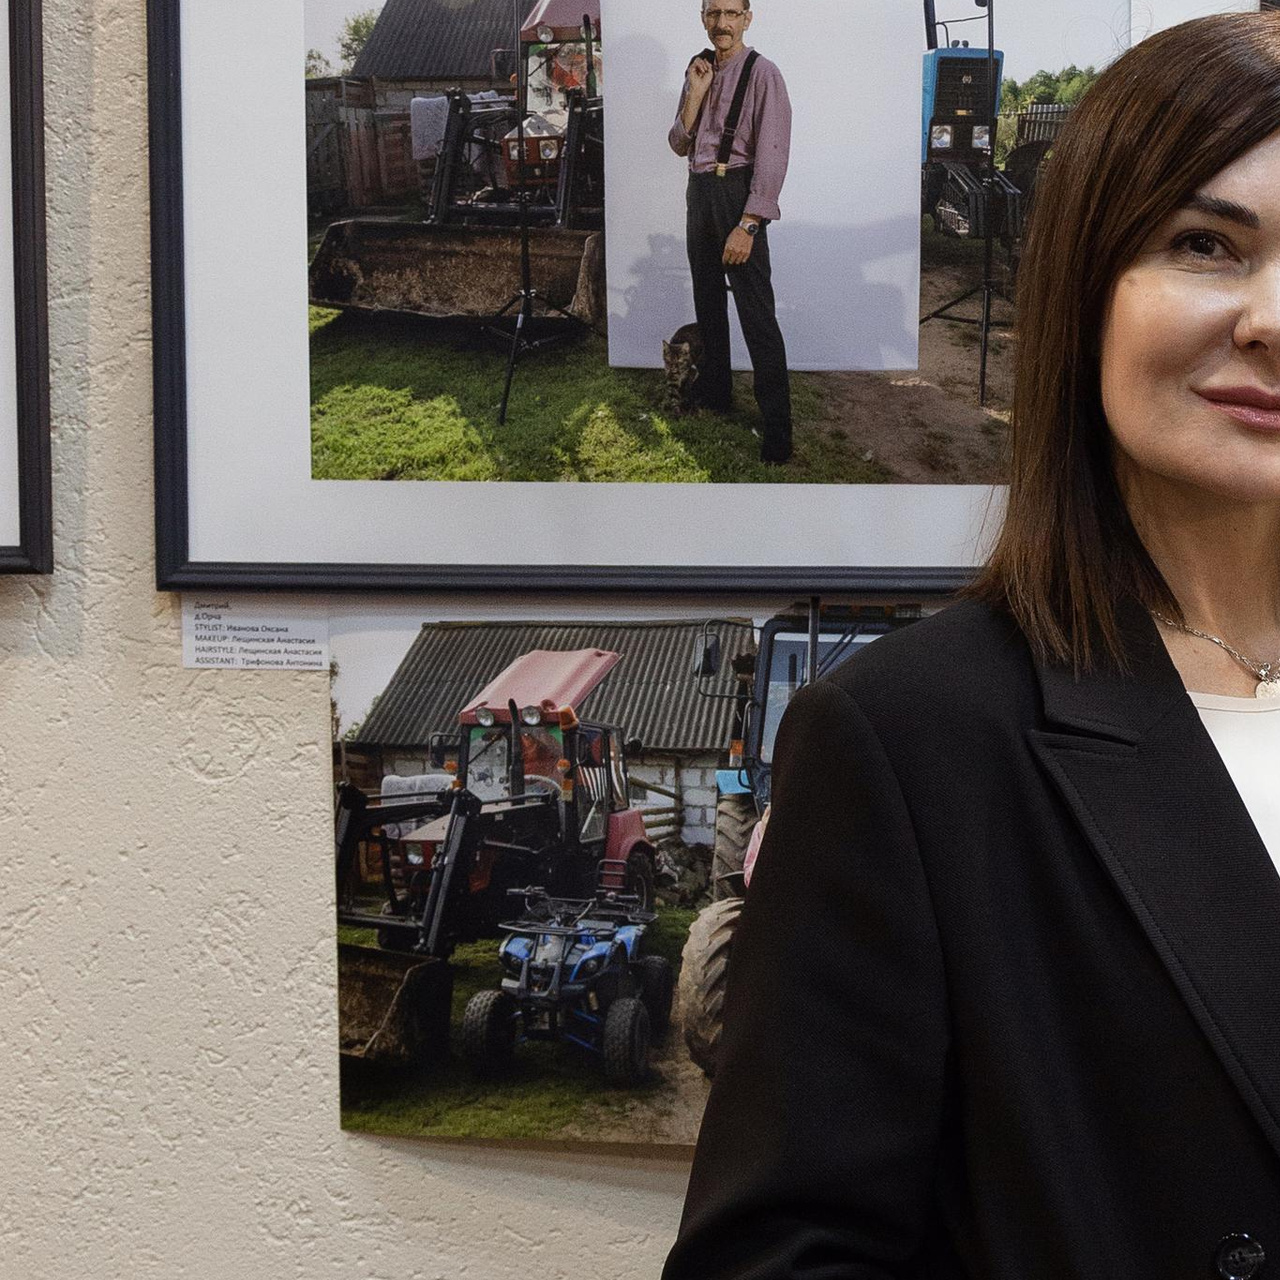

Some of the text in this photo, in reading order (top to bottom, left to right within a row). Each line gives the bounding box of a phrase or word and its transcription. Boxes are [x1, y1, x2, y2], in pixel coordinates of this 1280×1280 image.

[232, 636, 274, 644] Лещинская
[195, 657, 237, 665] ASSISTANT:
[241, 658, 283, 666] Трифонова
